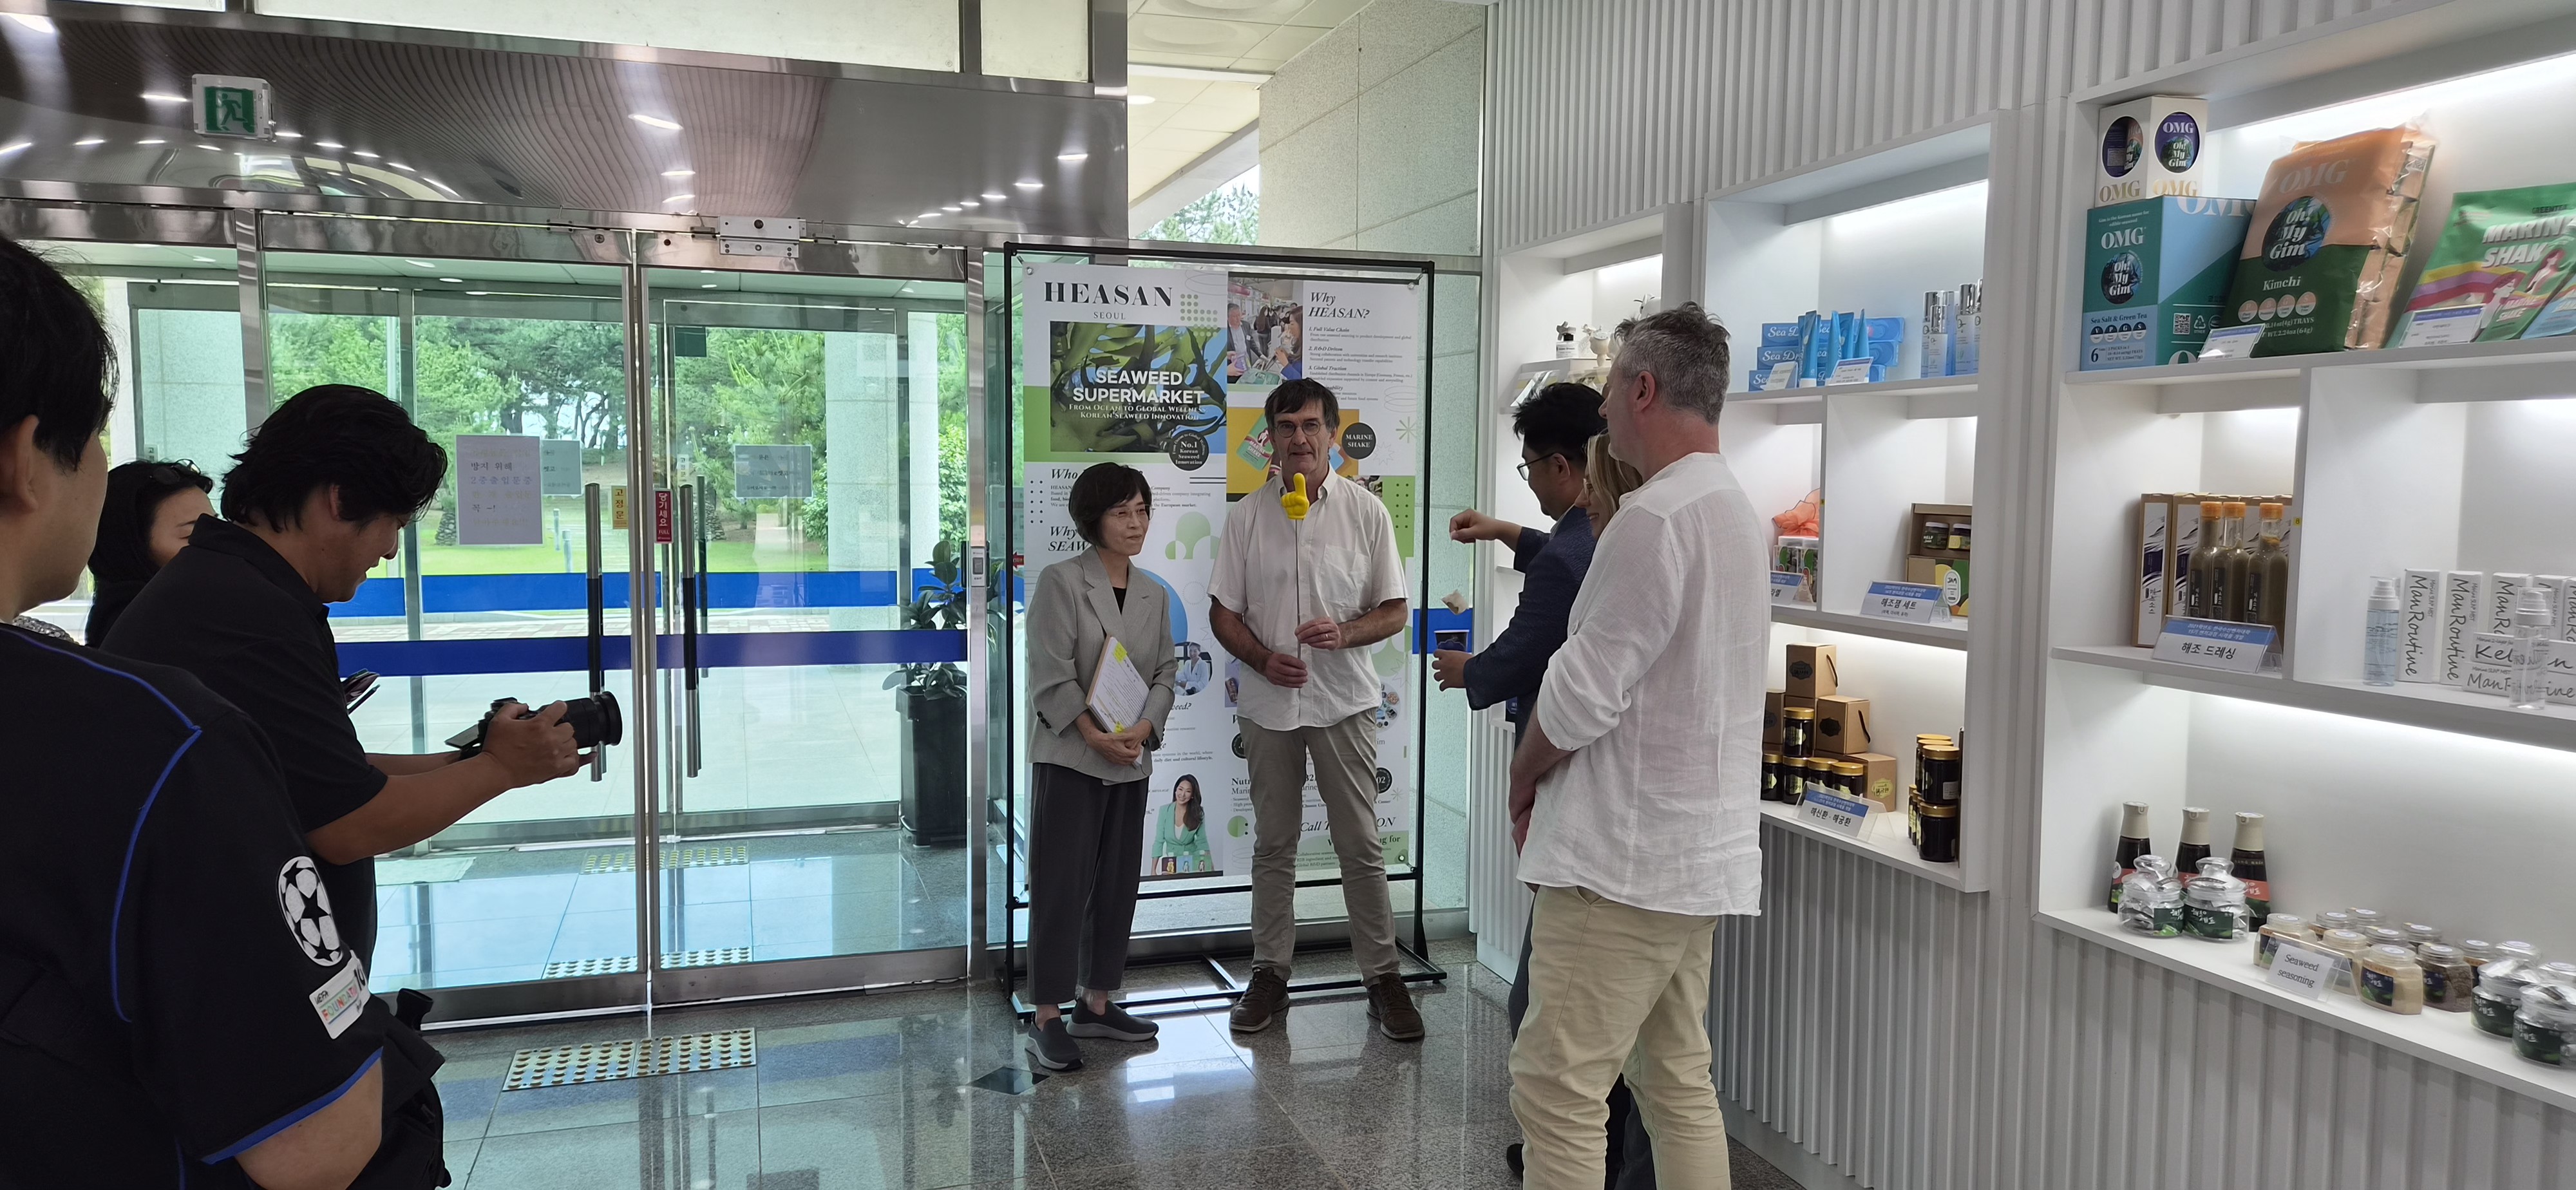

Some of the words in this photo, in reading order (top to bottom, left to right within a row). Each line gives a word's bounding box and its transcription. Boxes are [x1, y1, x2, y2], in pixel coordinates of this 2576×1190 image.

[2163, 122, 2195, 134] OMG
[2173, 150, 2185, 158] My
[2168, 159, 2187, 167] Gim
[2280, 160, 2351, 194] OMG
[2099, 180, 2141, 203] OMG
[2153, 178, 2198, 196] OMG
[2286, 207, 2311, 224] Oh!
[2101, 227, 2145, 249] OMG
[2278, 224, 2307, 242] My
[2269, 241, 2306, 260] Gim
[2481, 242, 2548, 268] SHAK
[2114, 261, 2130, 272] Oh!
[2112, 272, 2128, 285] My
[2262, 276, 2302, 291] Kimchi
[1045, 281, 1173, 307] HEASAN
[2109, 284, 2131, 296] Gim
[1311, 292, 1336, 307] Why
[1094, 312, 1126, 320] SEOUL
[1308, 307, 1370, 319] HEASAN?
[1768, 326, 1786, 337] Sea
[1762, 350, 1781, 362] Sea
[2090, 347, 2099, 363] 6
[1095, 370, 1183, 386] SEAWEED
[1072, 388, 1206, 404] SUPERMARKET
[471, 462, 489, 471] 방지
[495, 462, 513, 471] 위해
[1051, 469, 1078, 479] Who
[470, 475, 533, 485] 2중출입문중
[615, 489, 624, 520] 고정문
[659, 493, 668, 527] 당기세요
[1050, 526, 1077, 539] Why
[1048, 541, 1089, 551] SEAW
[1881, 598, 1902, 609] 해조잼
[1902, 600, 1917, 610] 세트
[2405, 575, 2429, 676] ManRoutine
[2447, 578, 2470, 681] ManRoutine
[2181, 642, 2201, 654] 해조
[2204, 645, 2237, 659] 드레싱
[1810, 807, 1828, 820] 해신환
[1832, 814, 1852, 827] 해궁환
[1300, 821, 1321, 832] Call
[1389, 835, 1401, 843] for
[2284, 954, 2320, 972] Seaweed
[2277, 968, 2315, 988] seasoning
[321, 985, 357, 1021] FOUNDAT
